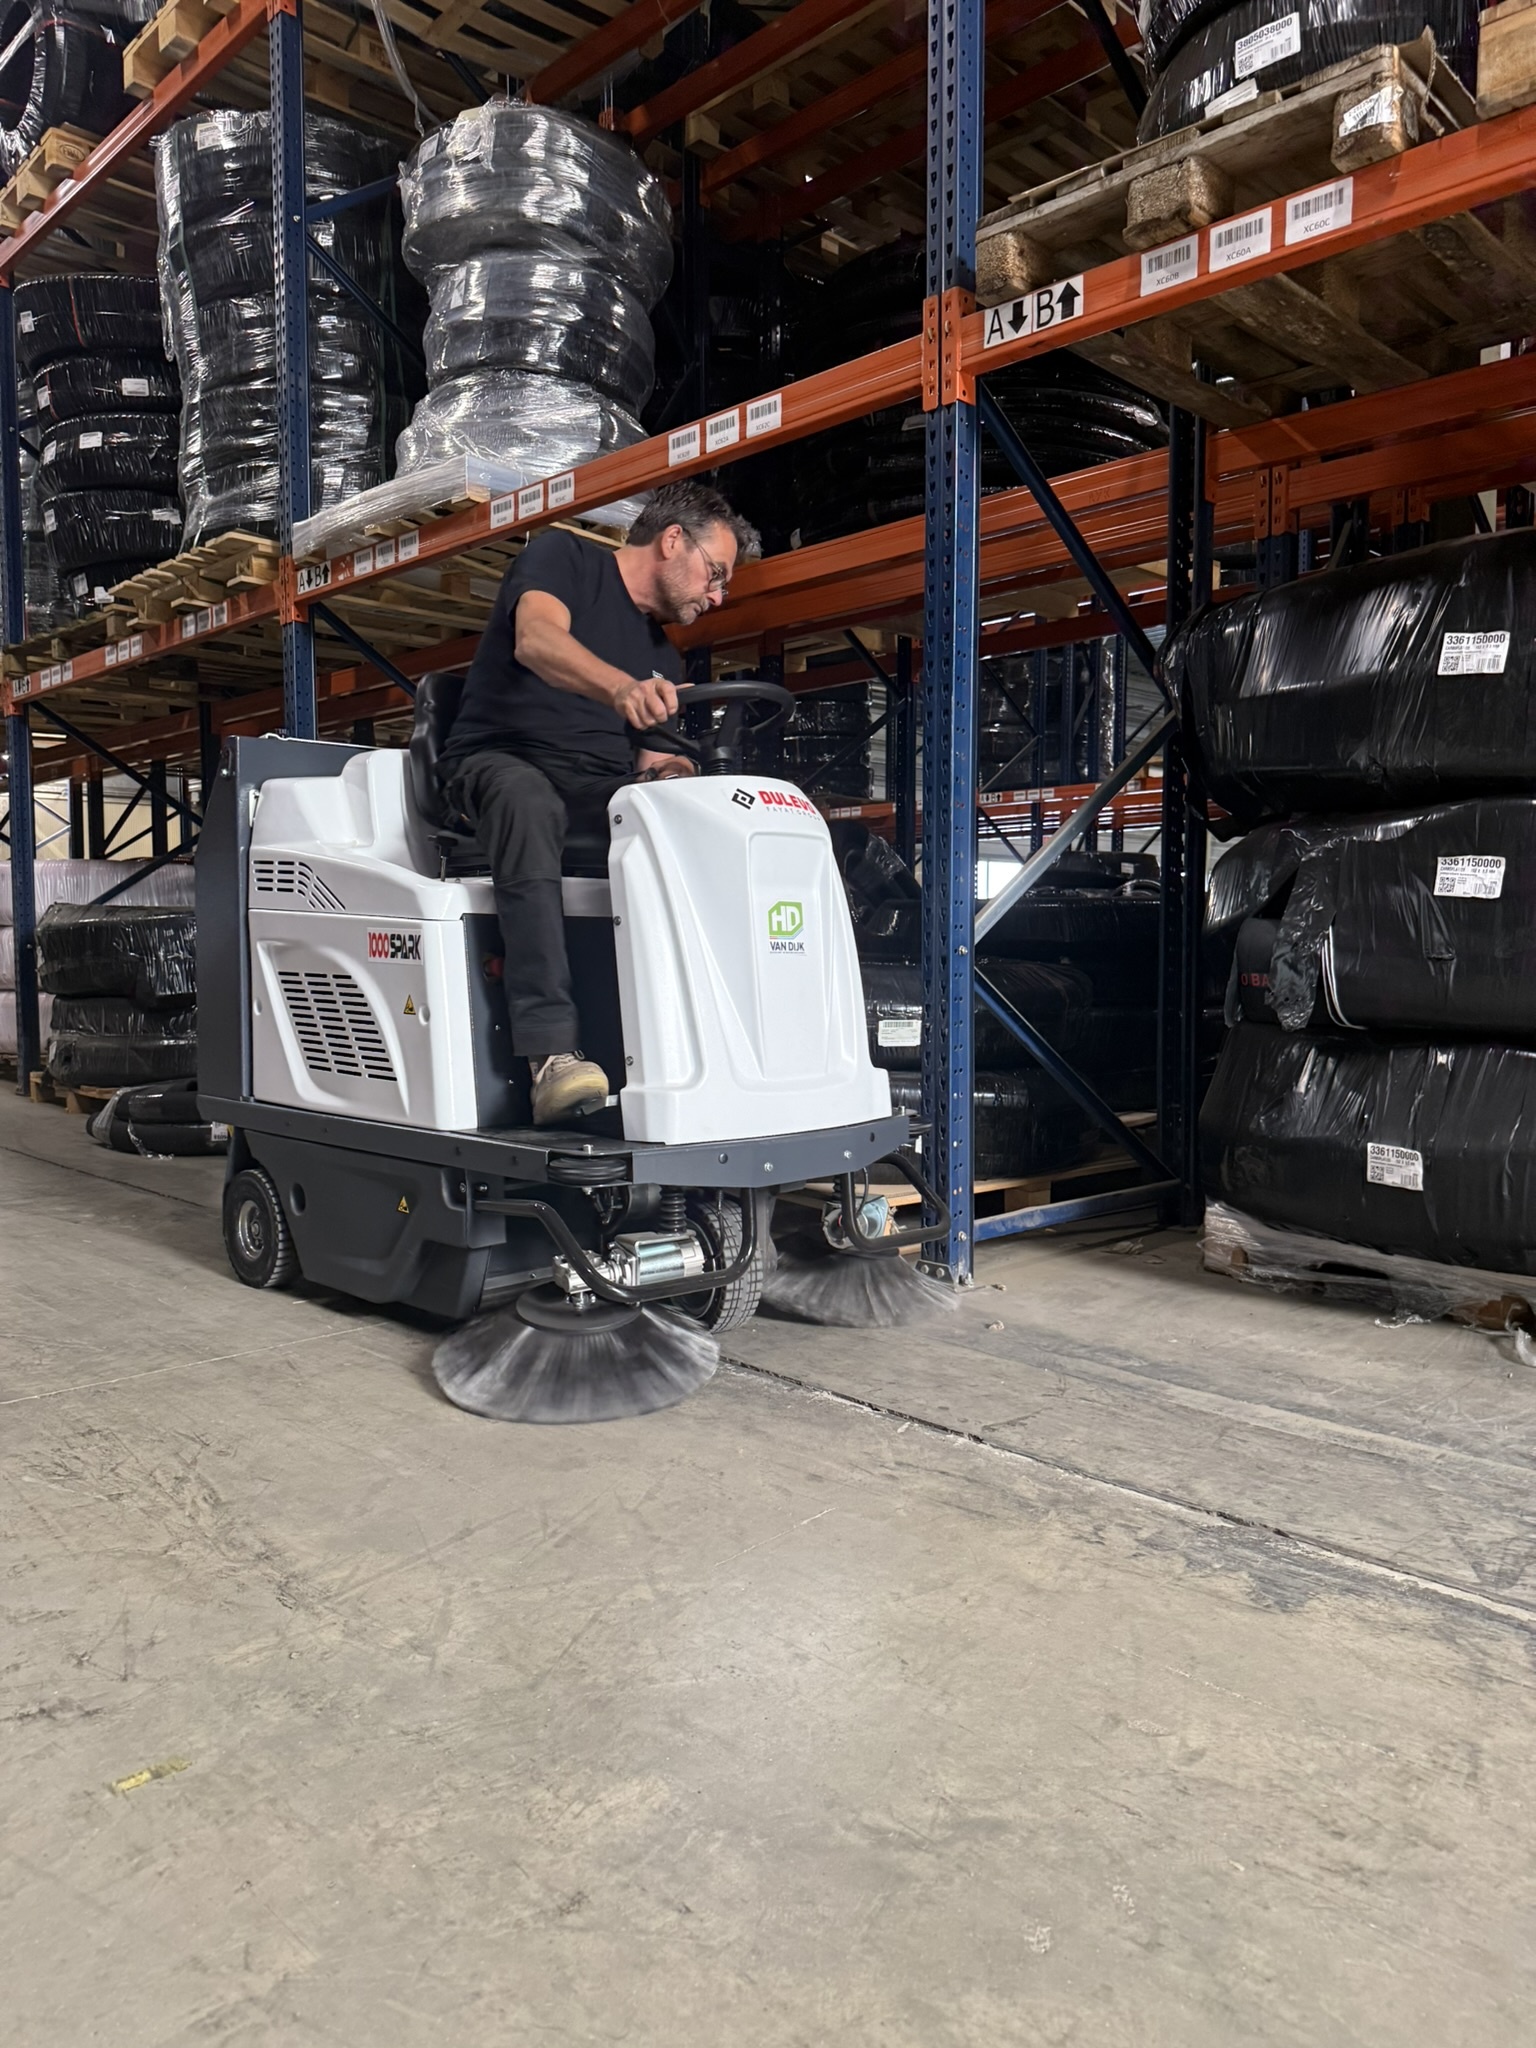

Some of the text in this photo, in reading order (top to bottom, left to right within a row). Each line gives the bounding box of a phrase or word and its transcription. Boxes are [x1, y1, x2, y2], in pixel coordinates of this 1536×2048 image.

[1237, 17, 1293, 50] 3805038000
[1303, 217, 1331, 234] XC60C
[1226, 246, 1251, 262] XC60A
[1156, 271, 1180, 286] XC60B
[986, 289, 1055, 344] A B
[298, 565, 322, 592] A B
[1446, 633, 1506, 645] 3361150000
[1441, 857, 1502, 869] 3361150000
[771, 905, 801, 932] HD
[770, 941, 805, 951] VAN DIJK
[1370, 1145, 1419, 1162] 3361150000
